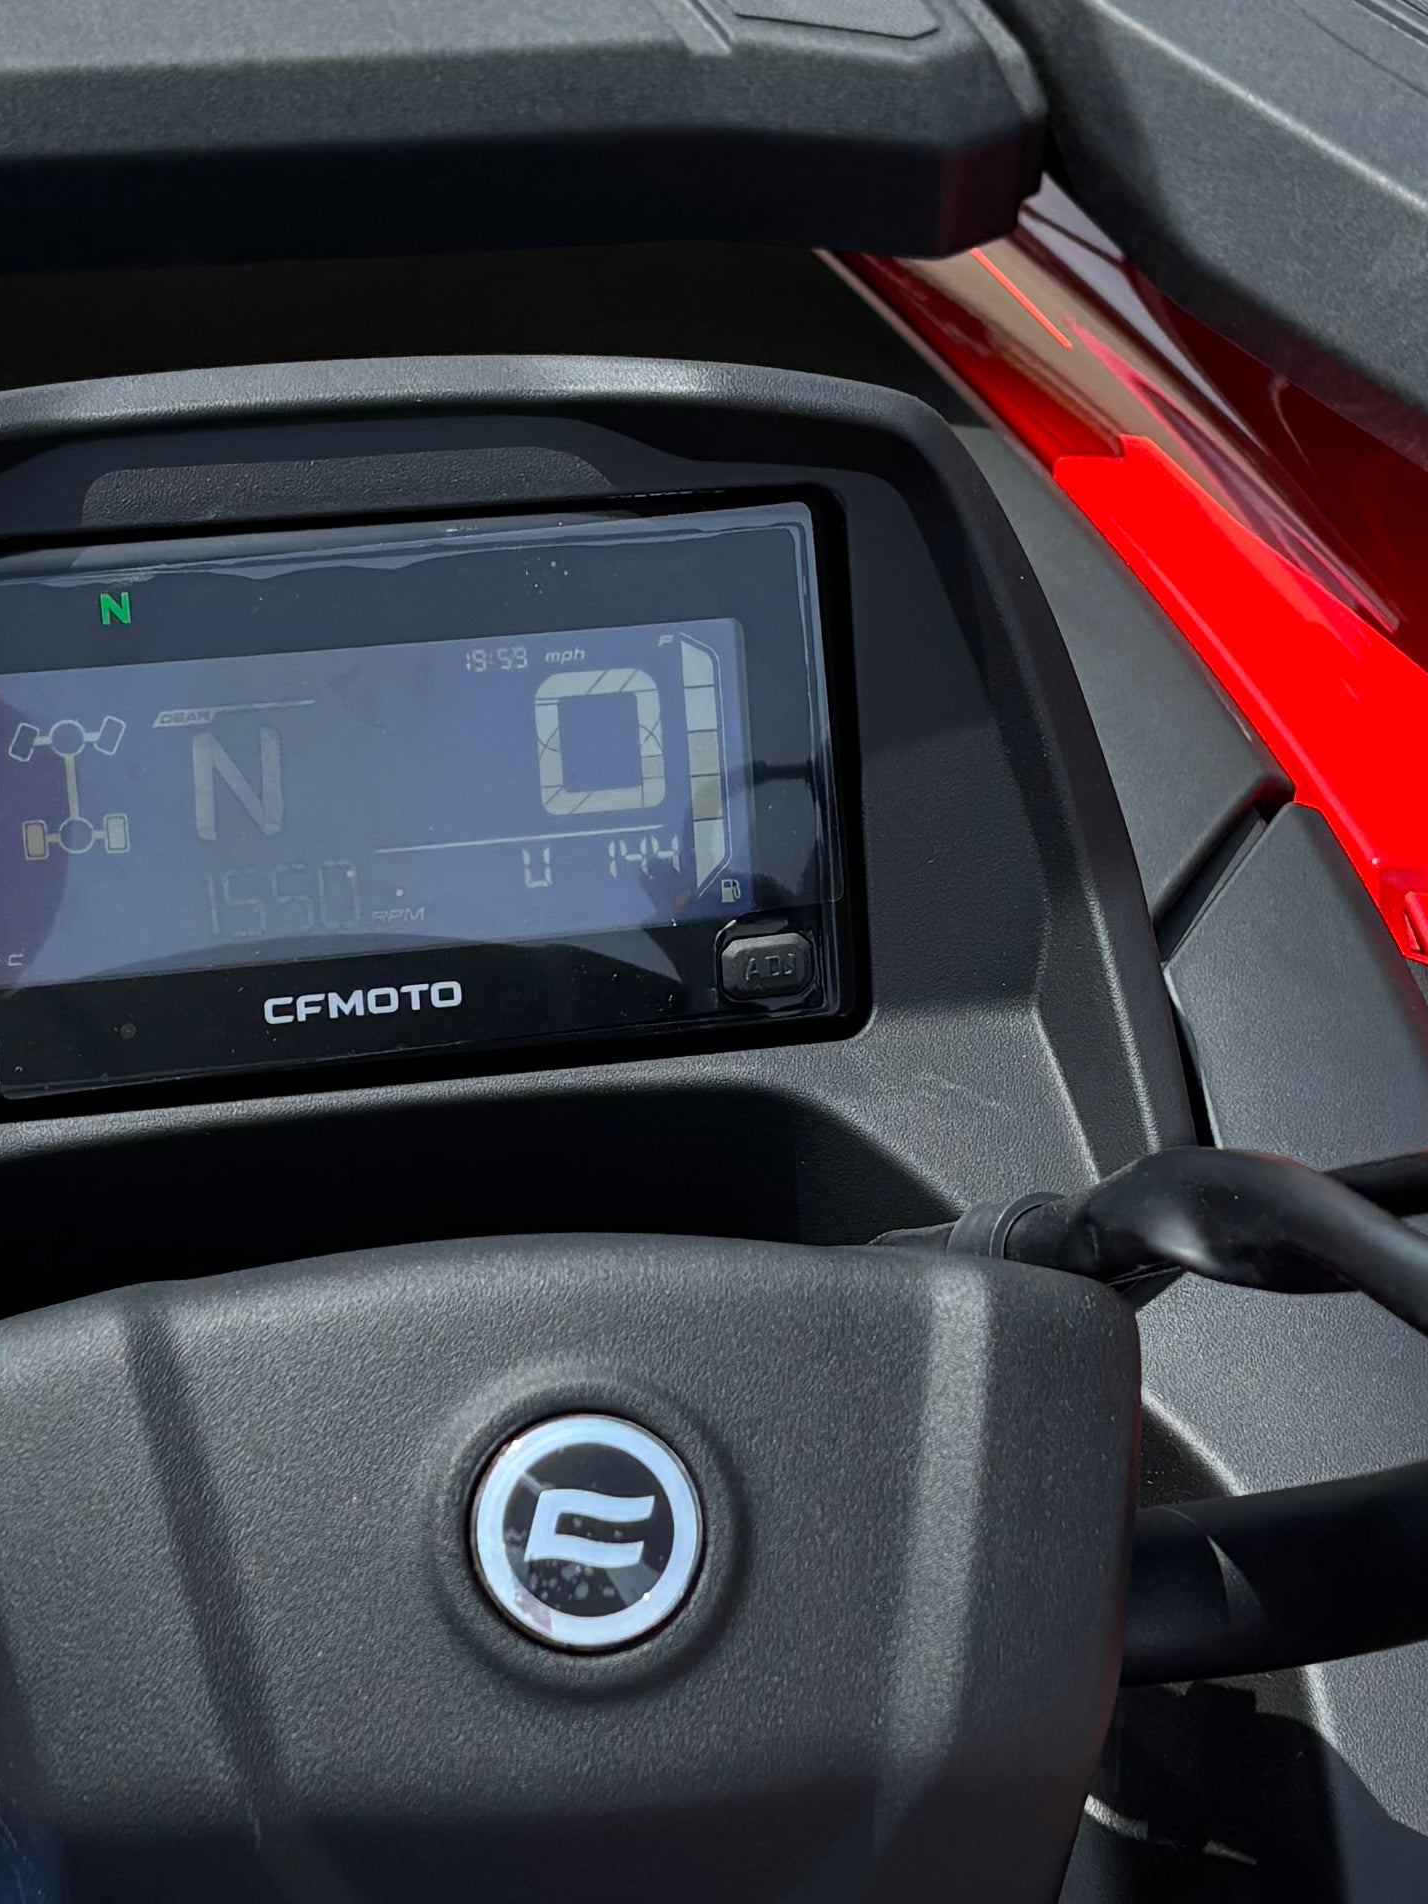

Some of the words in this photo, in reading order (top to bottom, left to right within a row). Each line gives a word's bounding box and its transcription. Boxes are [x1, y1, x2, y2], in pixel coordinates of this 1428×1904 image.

[100, 592, 131, 625] N
[466, 647, 527, 672] 19:59
[545, 648, 586, 665] mph
[160, 710, 210, 724] GEAR
[192, 726, 284, 841] N
[373, 907, 425, 921] RPM
[263, 981, 462, 1025] CFMOTO
